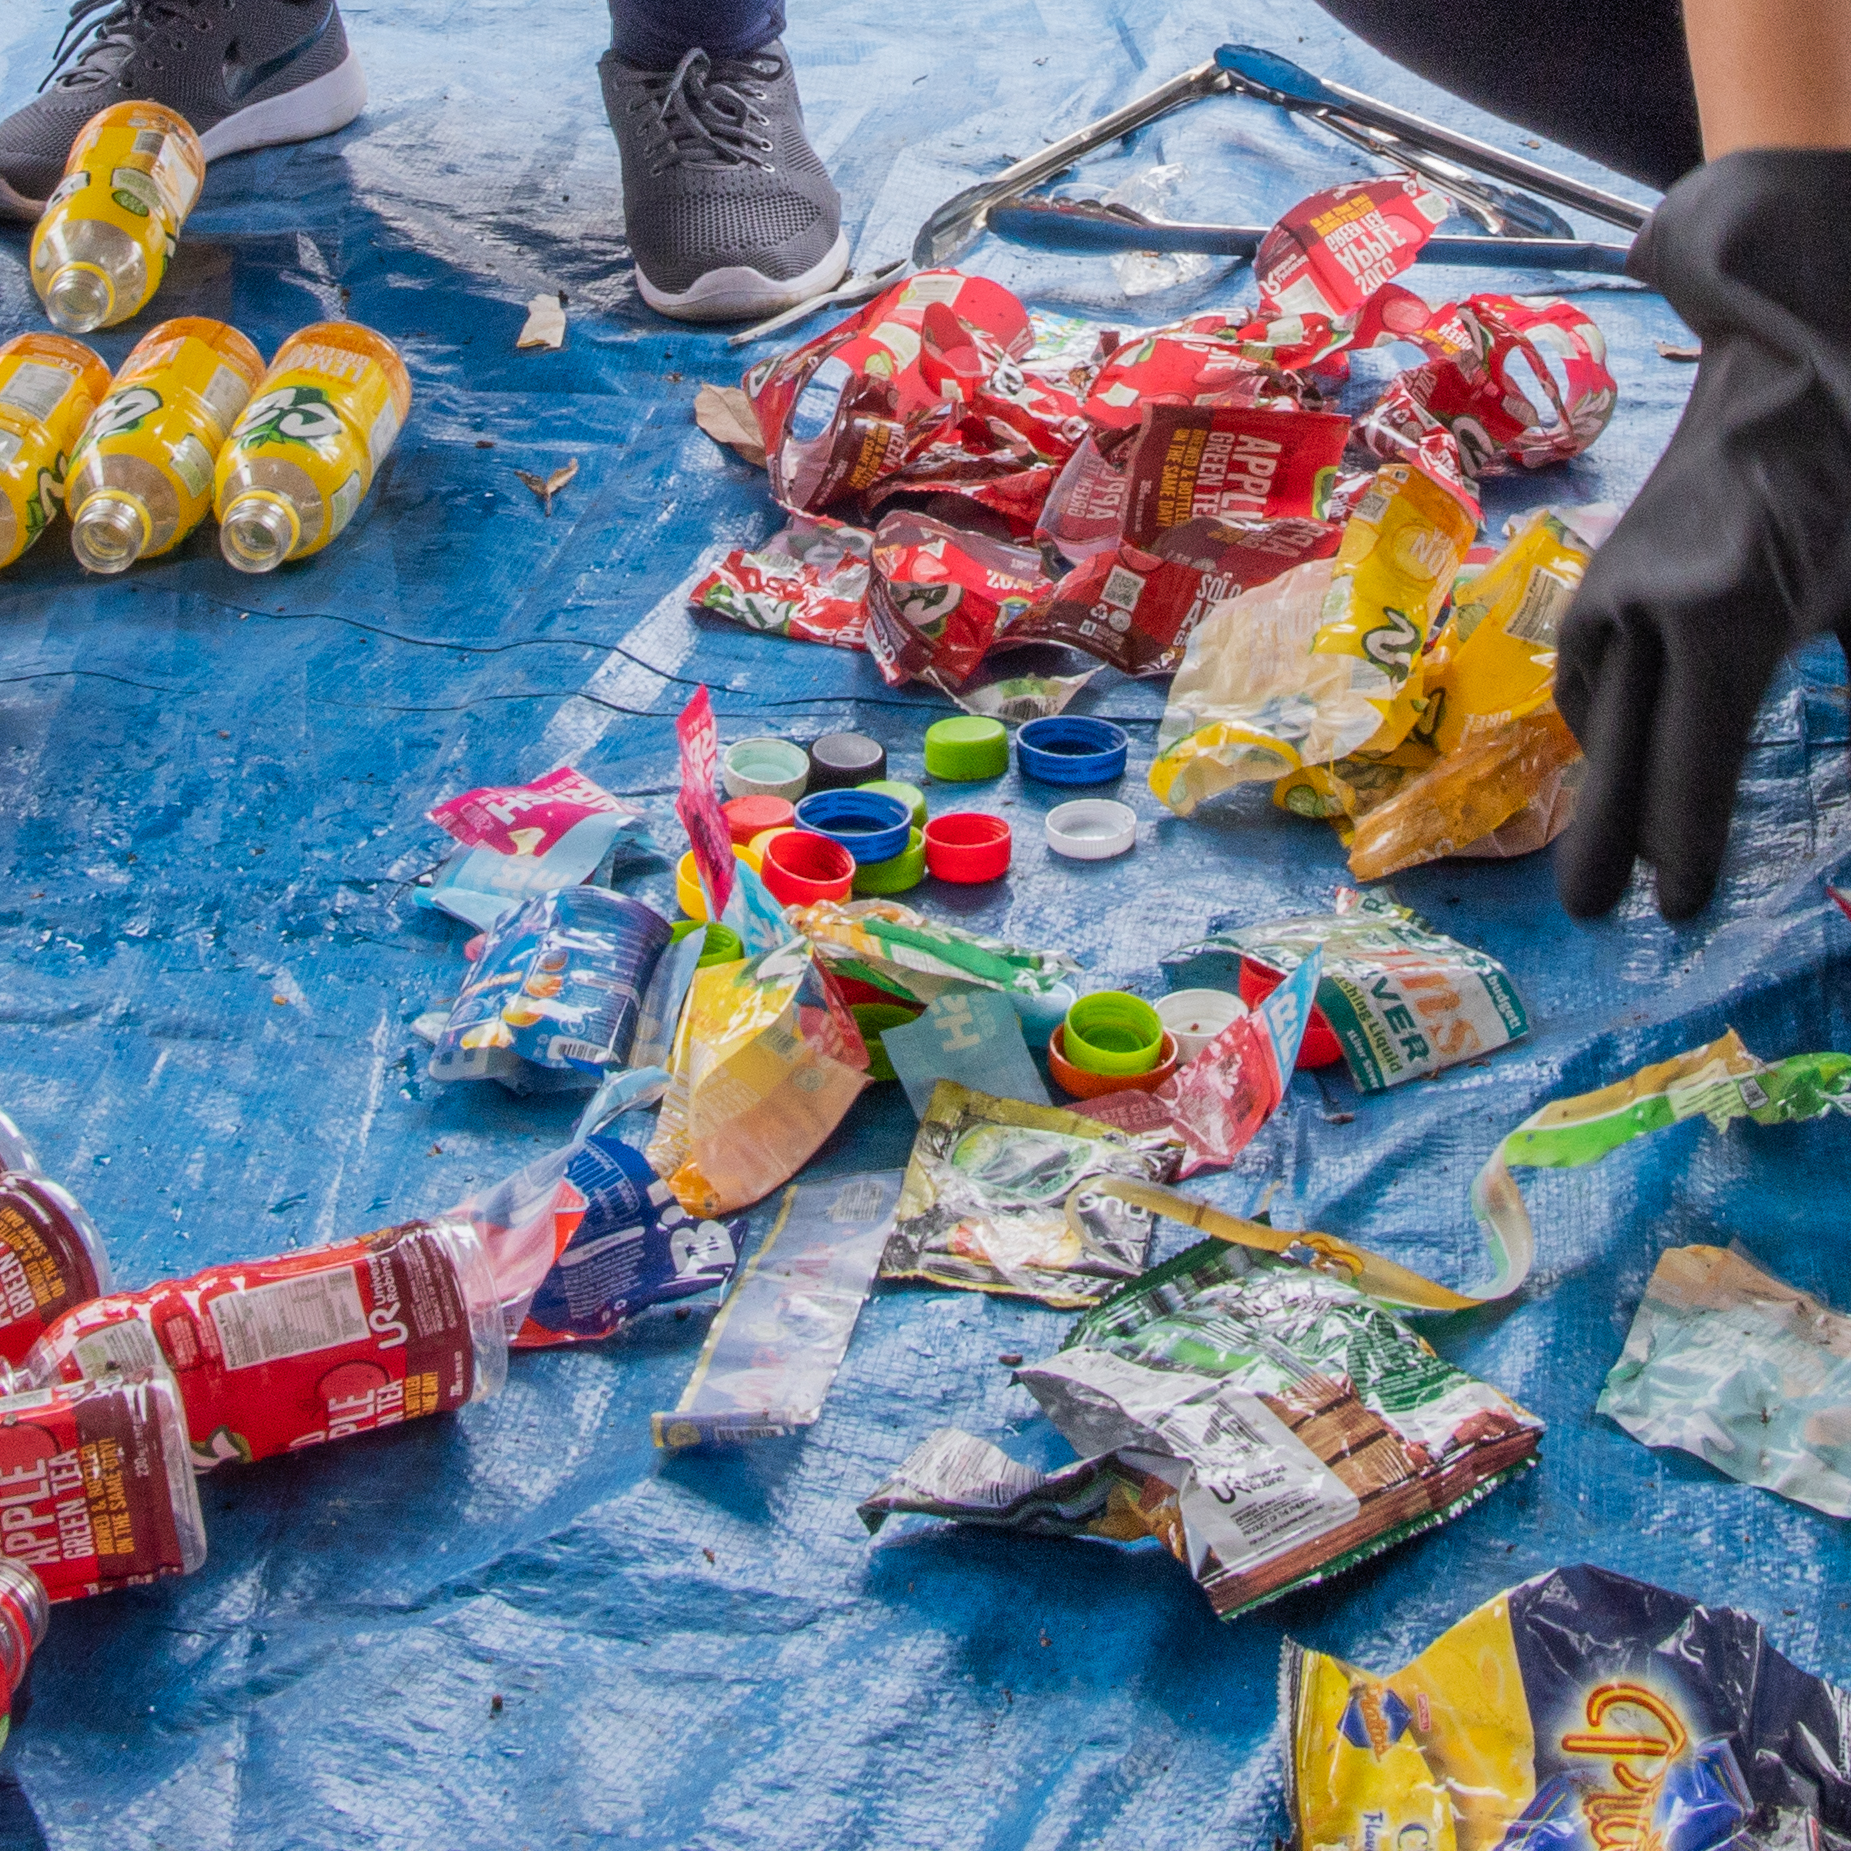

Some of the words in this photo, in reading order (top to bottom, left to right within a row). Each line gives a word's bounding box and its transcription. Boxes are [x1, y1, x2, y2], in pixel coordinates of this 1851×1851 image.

[1199, 431, 1235, 487] GREEN
[1193, 487, 1226, 518] TE
[1368, 1016, 1404, 1075] Liquid
[368, 1300, 410, 1351] UR
[49, 1448, 84, 1496] TEA
[107, 1481, 126, 1514] SAME
[55, 1499, 95, 1560] GREEN
